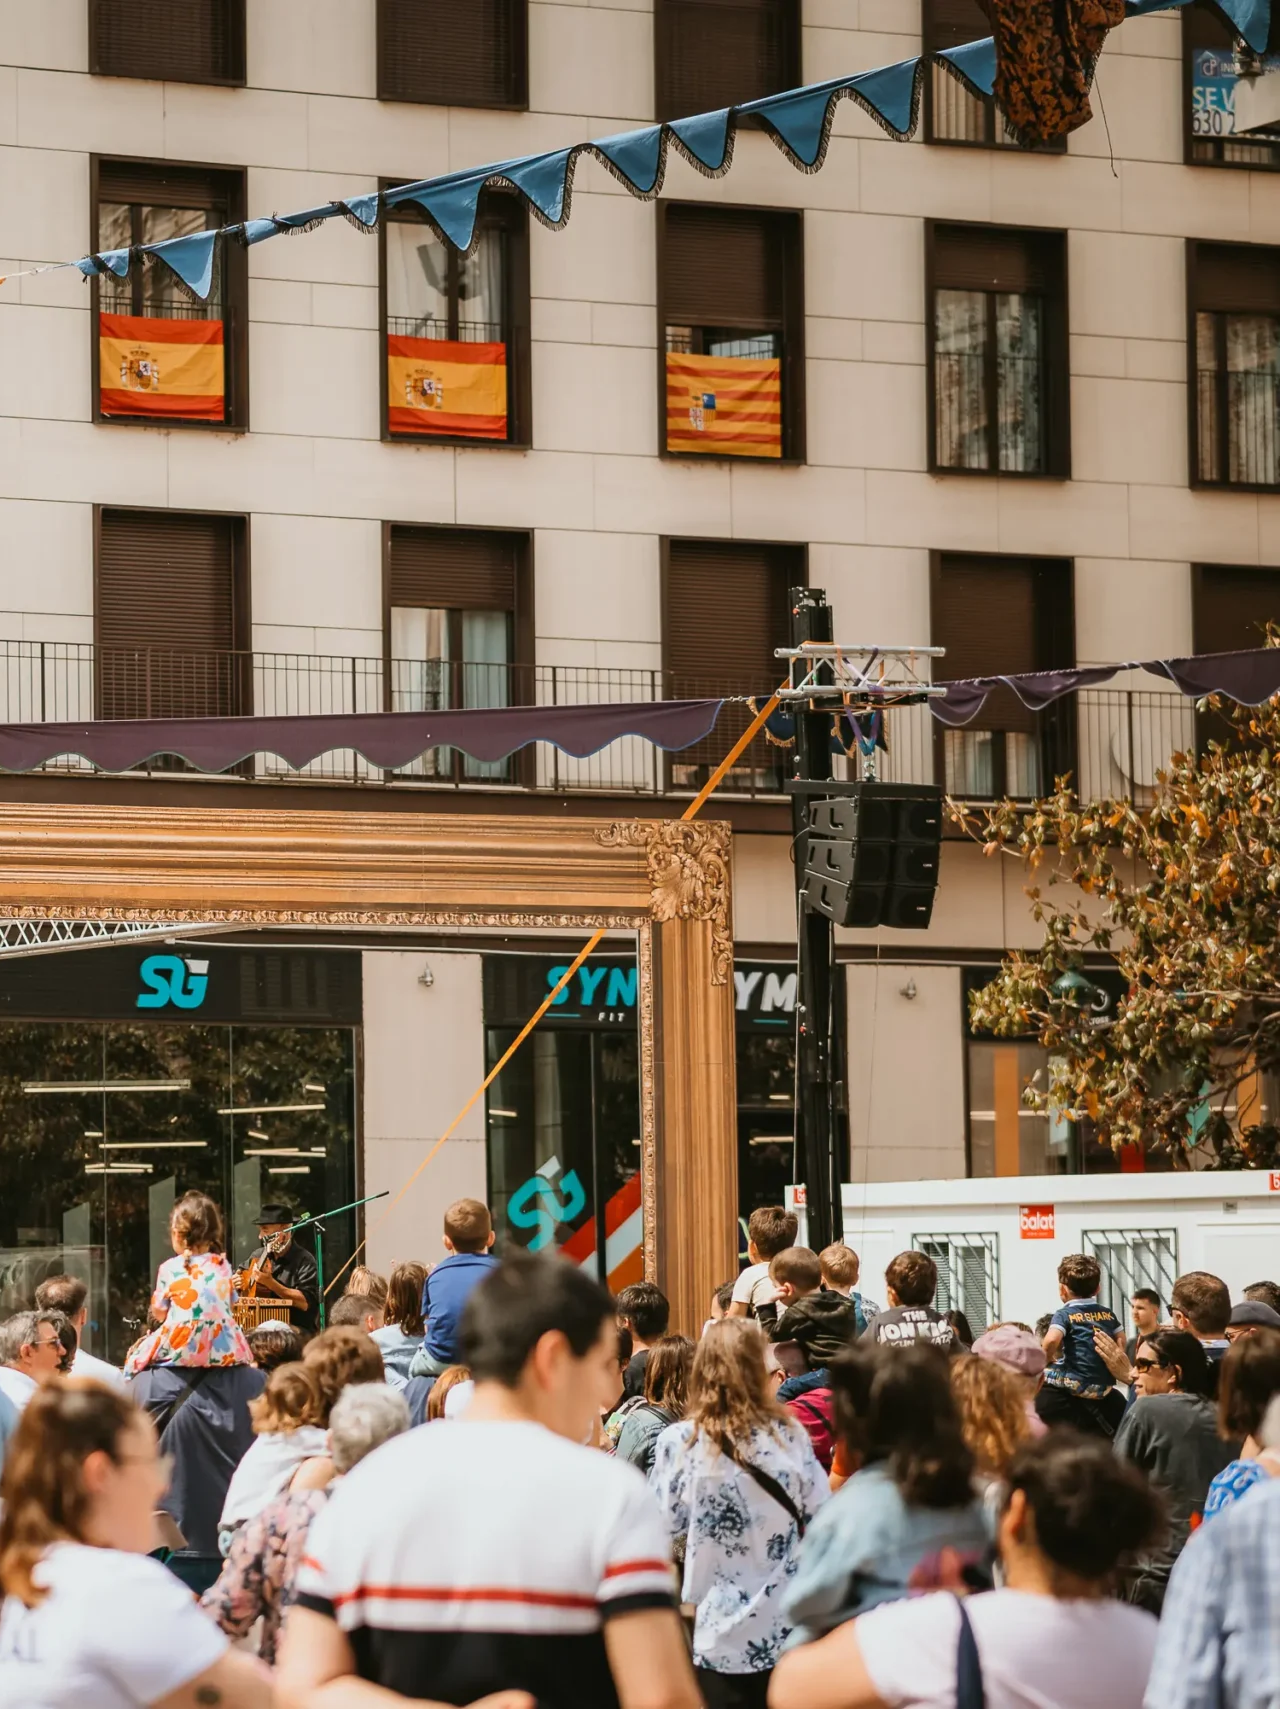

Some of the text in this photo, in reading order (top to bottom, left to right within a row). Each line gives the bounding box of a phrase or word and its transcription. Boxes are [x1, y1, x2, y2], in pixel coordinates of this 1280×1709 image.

[1192, 109, 1222, 135] 630
[598, 1011, 626, 1023] FIT
[902, 1310, 928, 1322] THE
[1084, 1311, 1115, 1322] SHARK
